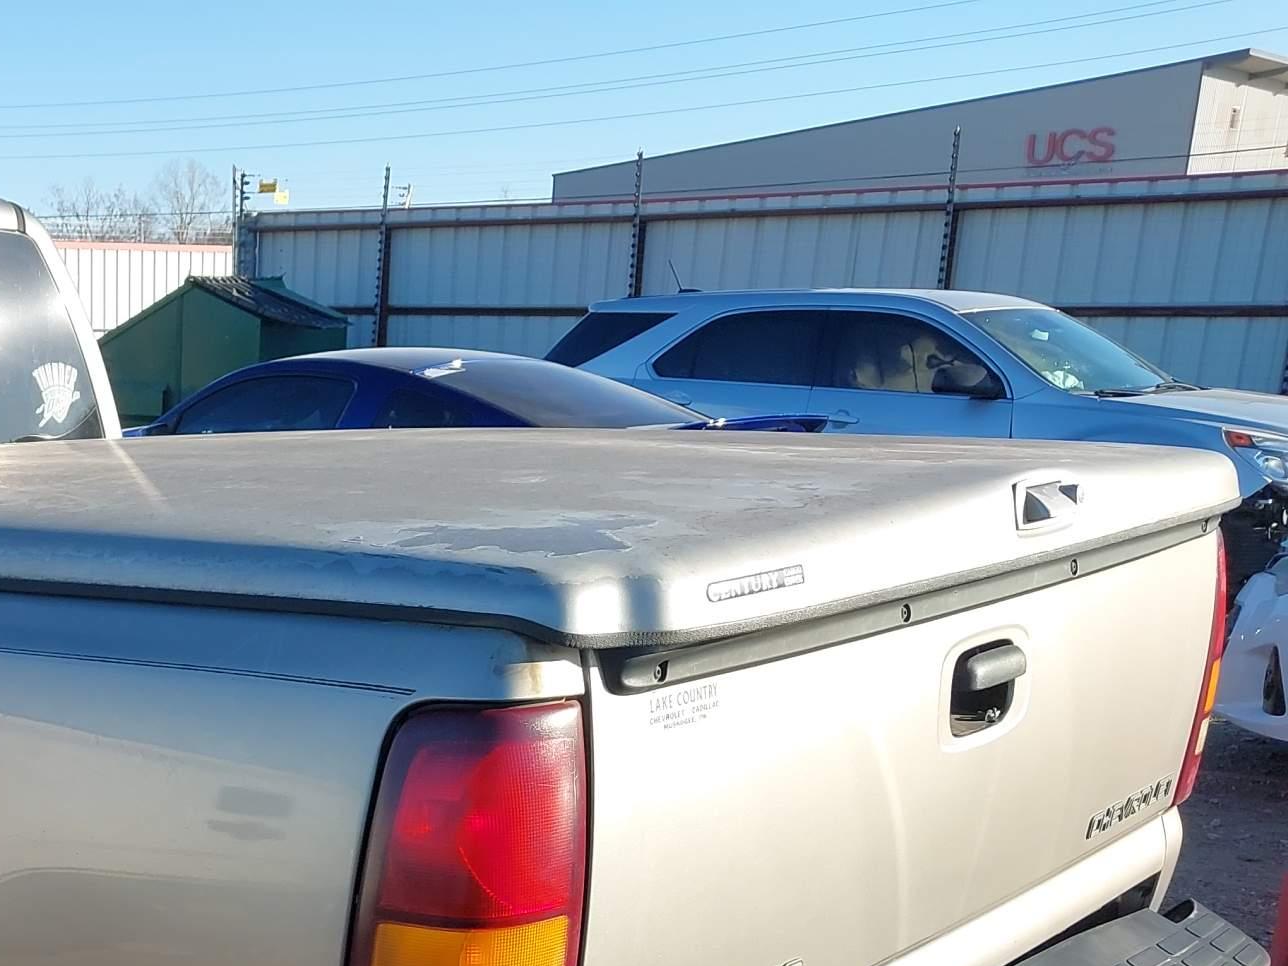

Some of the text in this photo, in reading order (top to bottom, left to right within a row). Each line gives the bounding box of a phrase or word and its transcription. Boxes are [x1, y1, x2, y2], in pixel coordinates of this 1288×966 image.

[1025, 127, 1116, 164] UCS
[650, 682, 718, 713] LAKE COUNTRY
